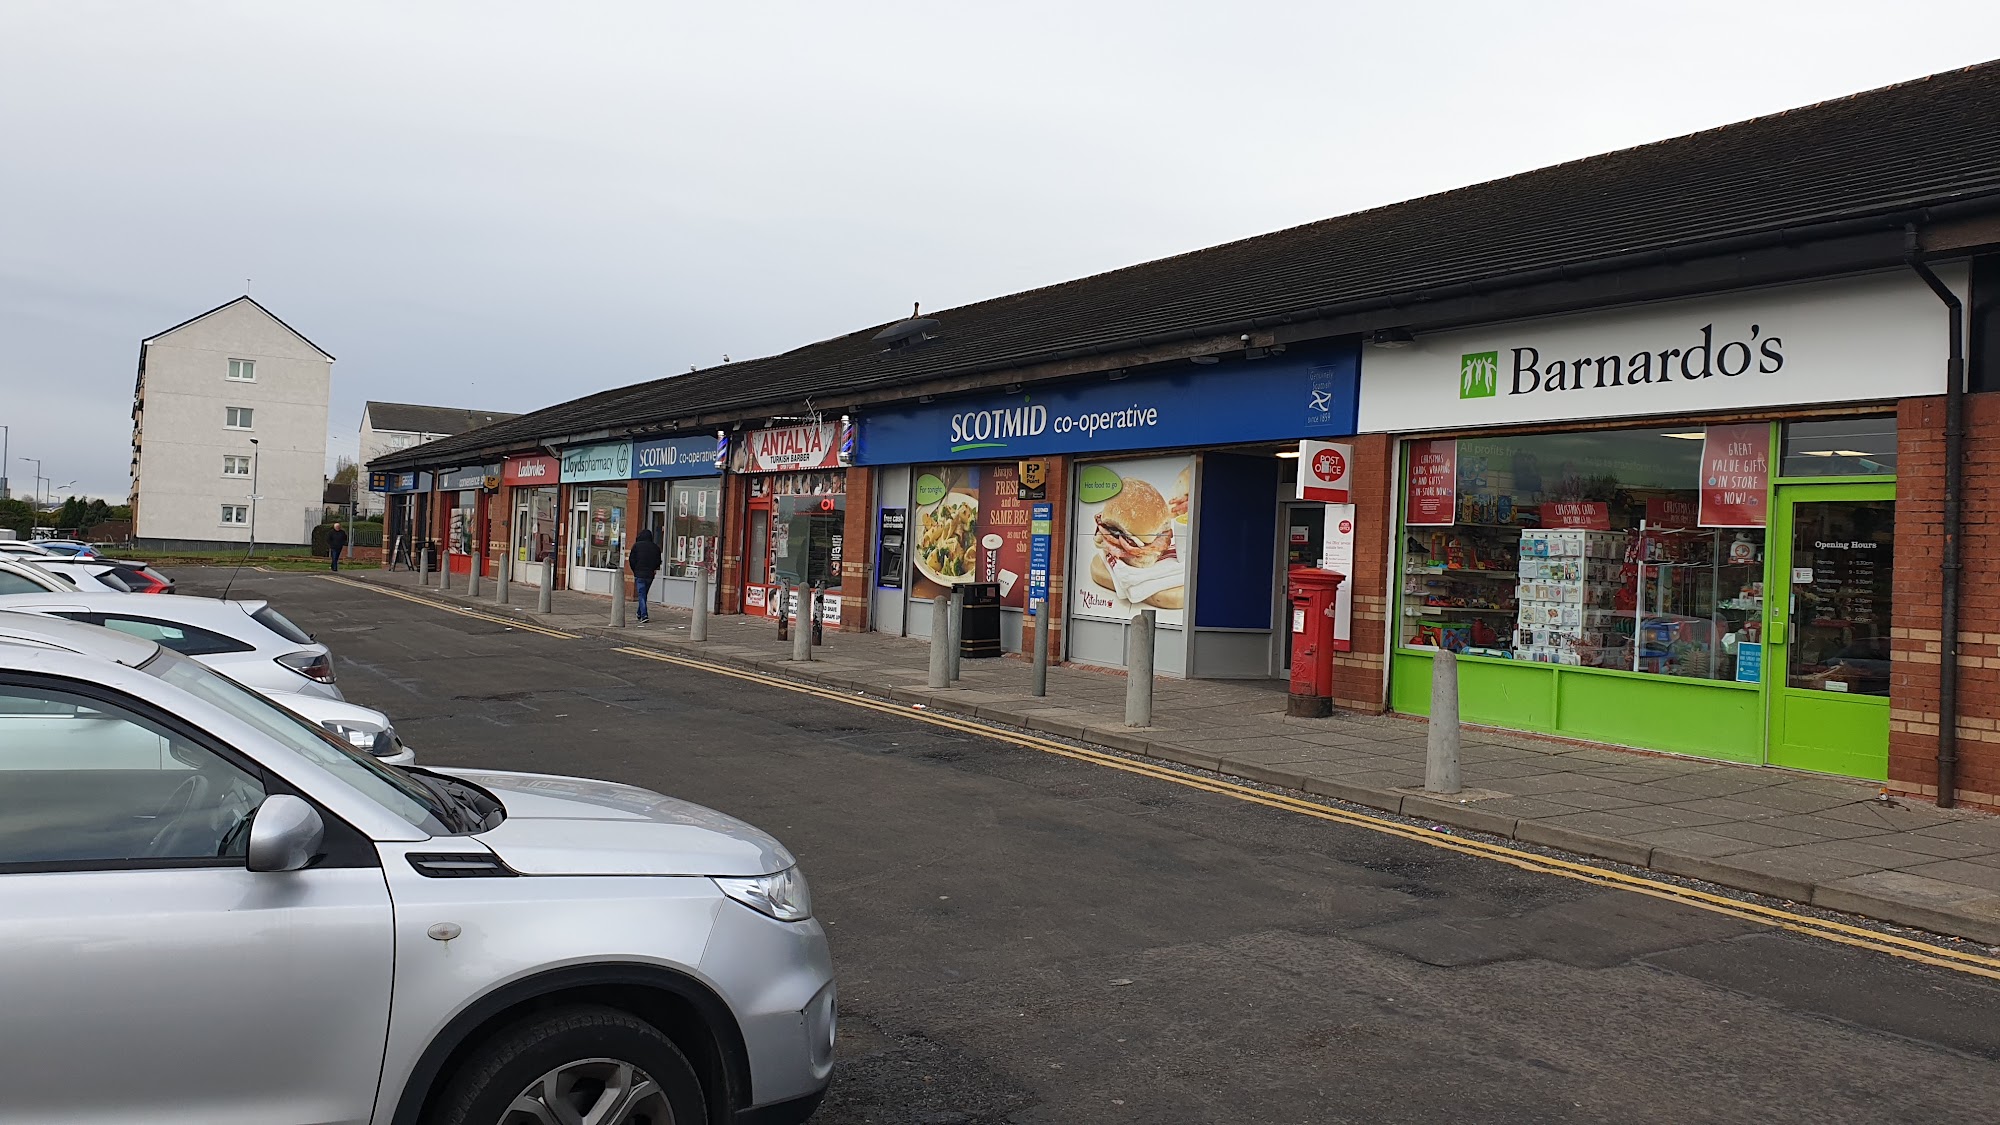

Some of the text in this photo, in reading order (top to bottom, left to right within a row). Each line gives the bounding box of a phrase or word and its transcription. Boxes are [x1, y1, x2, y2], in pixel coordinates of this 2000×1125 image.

[1508, 323, 1784, 396] Barnardo's
[950, 403, 1158, 443] SCOTMID co-operative
[760, 427, 823, 457] ANTALYA
[1474, 444, 1505, 457] profits
[1728, 442, 1753, 456] GREAT
[639, 446, 718, 467] SCOTMID co-operative
[770, 453, 810, 464] TURKISH BARBER
[1320, 454, 1340, 465] POST
[1420, 453, 1444, 465] CHRISTMAS
[517, 459, 546, 478] Ladbrokes
[563, 455, 614, 478] Lloydspharmacy
[993, 466, 1013, 479] Always
[1314, 464, 1342, 475] OICE
[1429, 465, 1451, 475] WRAPPING
[1712, 459, 1767, 473] VALUE GIFTS
[1418, 476, 1428, 486] AND
[1718, 475, 1758, 489] IN STORE
[927, 486, 943, 495] tonight
[1001, 497, 1011, 508] and
[1724, 491, 1747, 505] NOW!
[1554, 503, 1596, 516] CHRISTMAS CARDS
[883, 513, 904, 523] free cash
[990, 509, 1013, 525] SAME
[1814, 540, 1877, 550] Opening Hours
[1083, 591, 1107, 609] Kitchen
